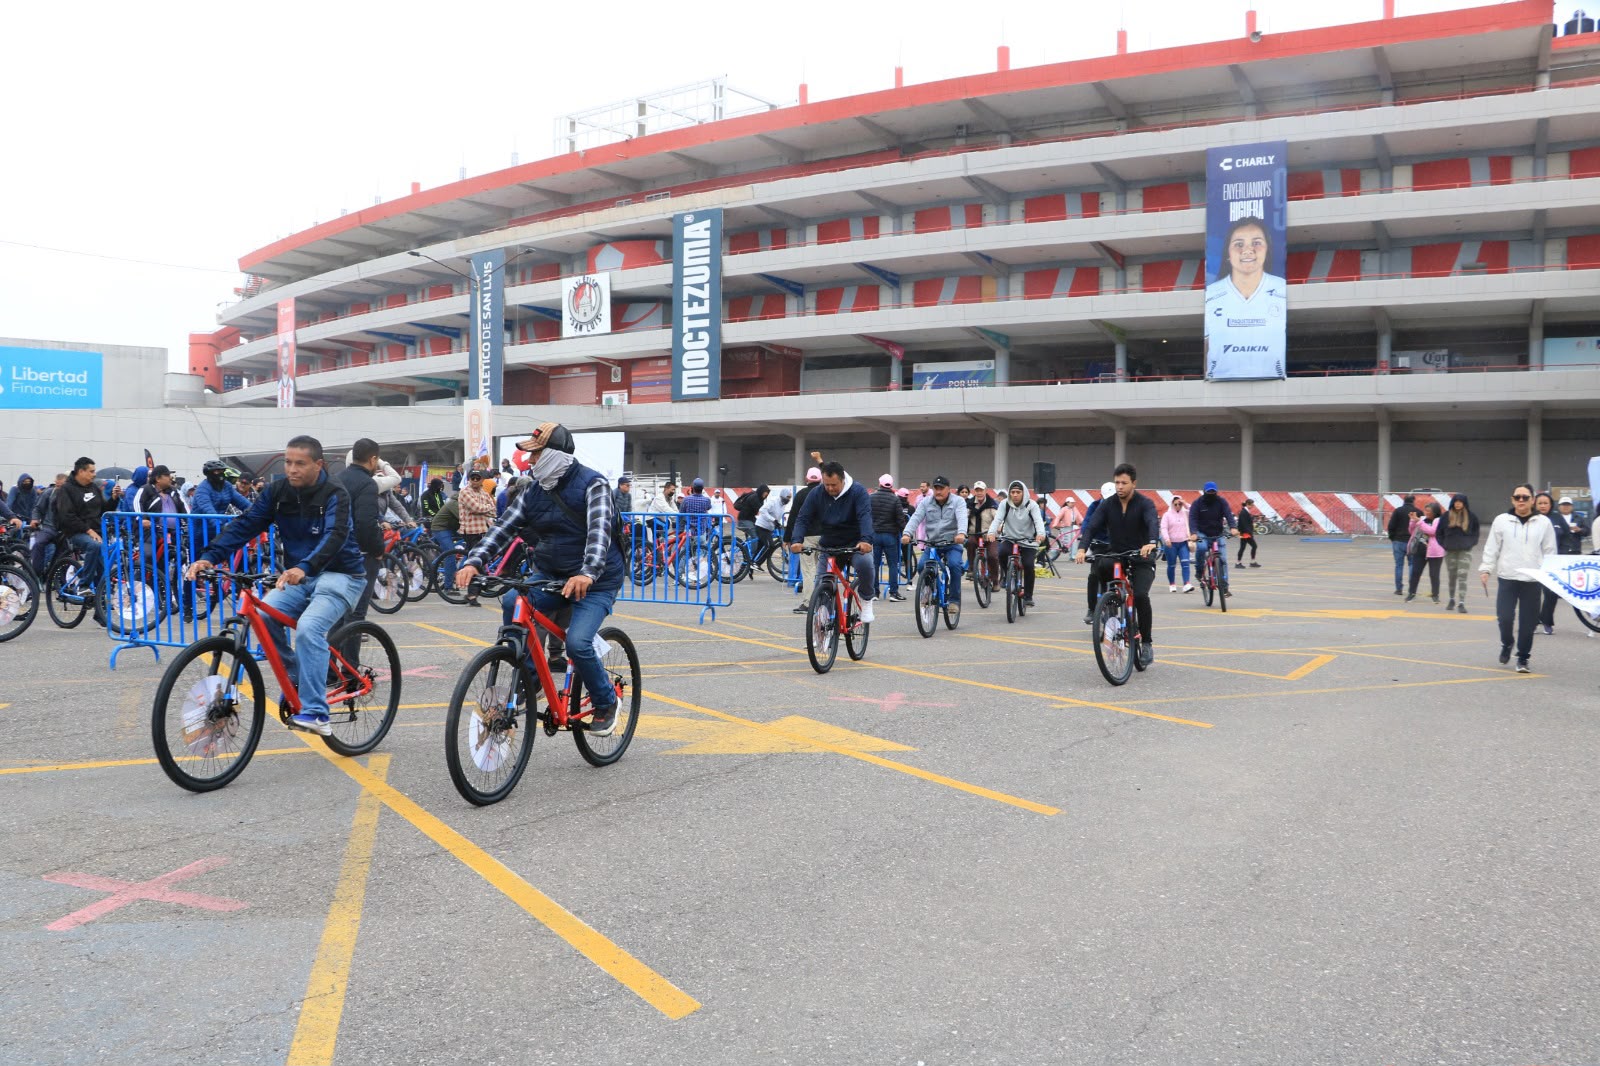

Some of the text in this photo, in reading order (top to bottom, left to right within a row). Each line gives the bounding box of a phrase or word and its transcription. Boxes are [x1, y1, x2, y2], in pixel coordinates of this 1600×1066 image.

[1235, 155, 1275, 168] CHARLY
[1223, 180, 1272, 201] ENYERLIANNYS
[1229, 199, 1265, 222] HIGUERA
[483, 261, 493, 293] LUIS
[482, 293, 492, 320] SAN
[682, 219, 711, 396] MOCTEZUMA
[482, 321, 492, 340] DE
[1231, 345, 1270, 353] DAIKIN
[12, 365, 88, 384] Libertad
[967, 379, 979, 387] UN
[11, 382, 88, 397] Financiera
